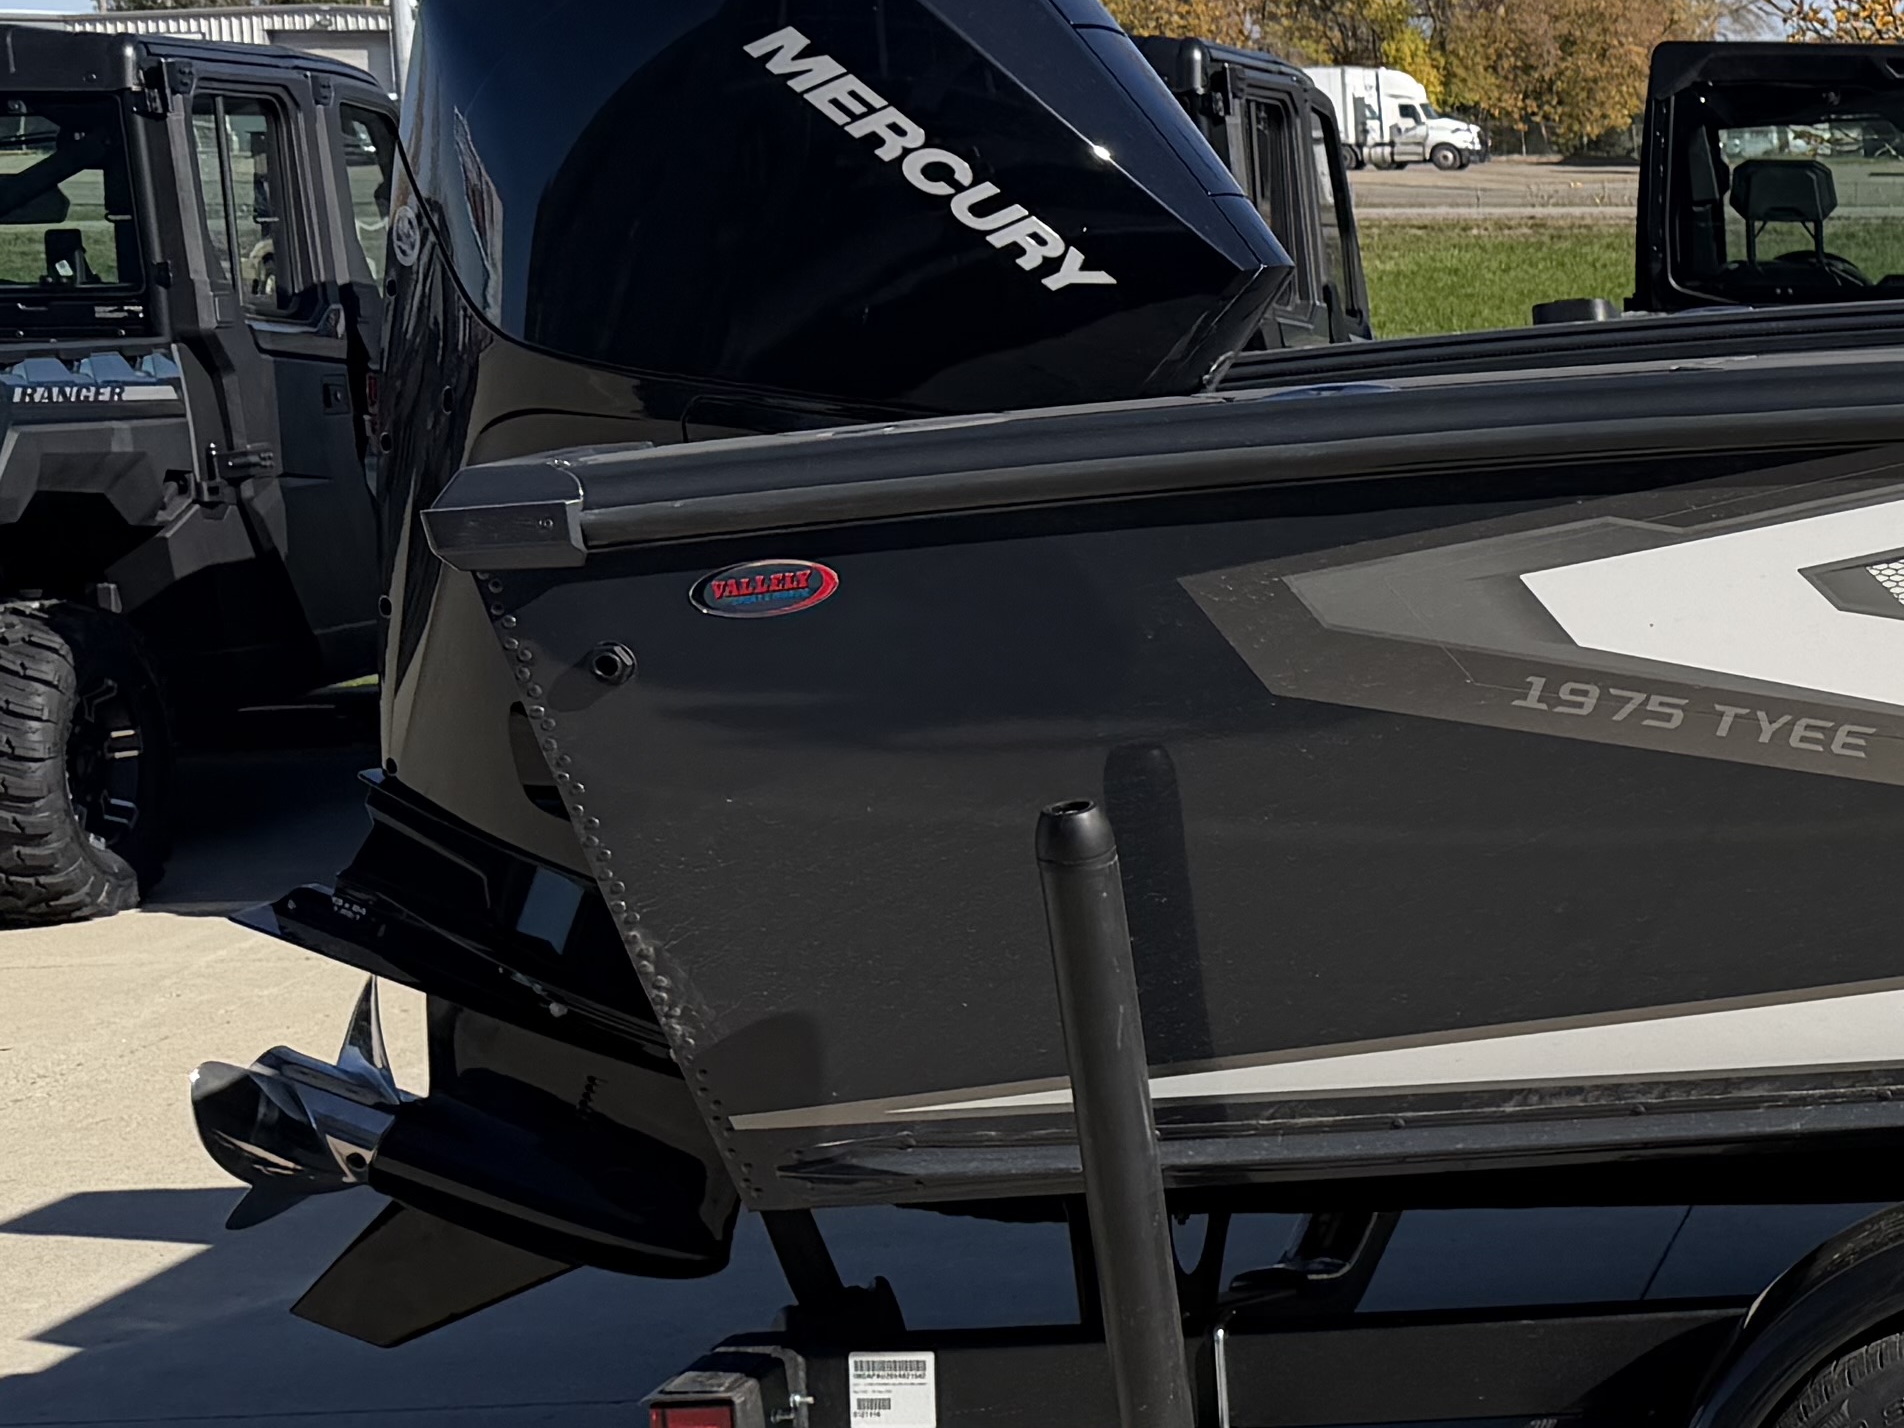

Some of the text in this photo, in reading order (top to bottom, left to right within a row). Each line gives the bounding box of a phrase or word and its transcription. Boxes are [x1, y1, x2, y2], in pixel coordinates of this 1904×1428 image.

[743, 25, 1118, 292] MERCURY
[17, 384, 126, 404] RANGER
[1511, 675, 1877, 760] 1975 TYEE
